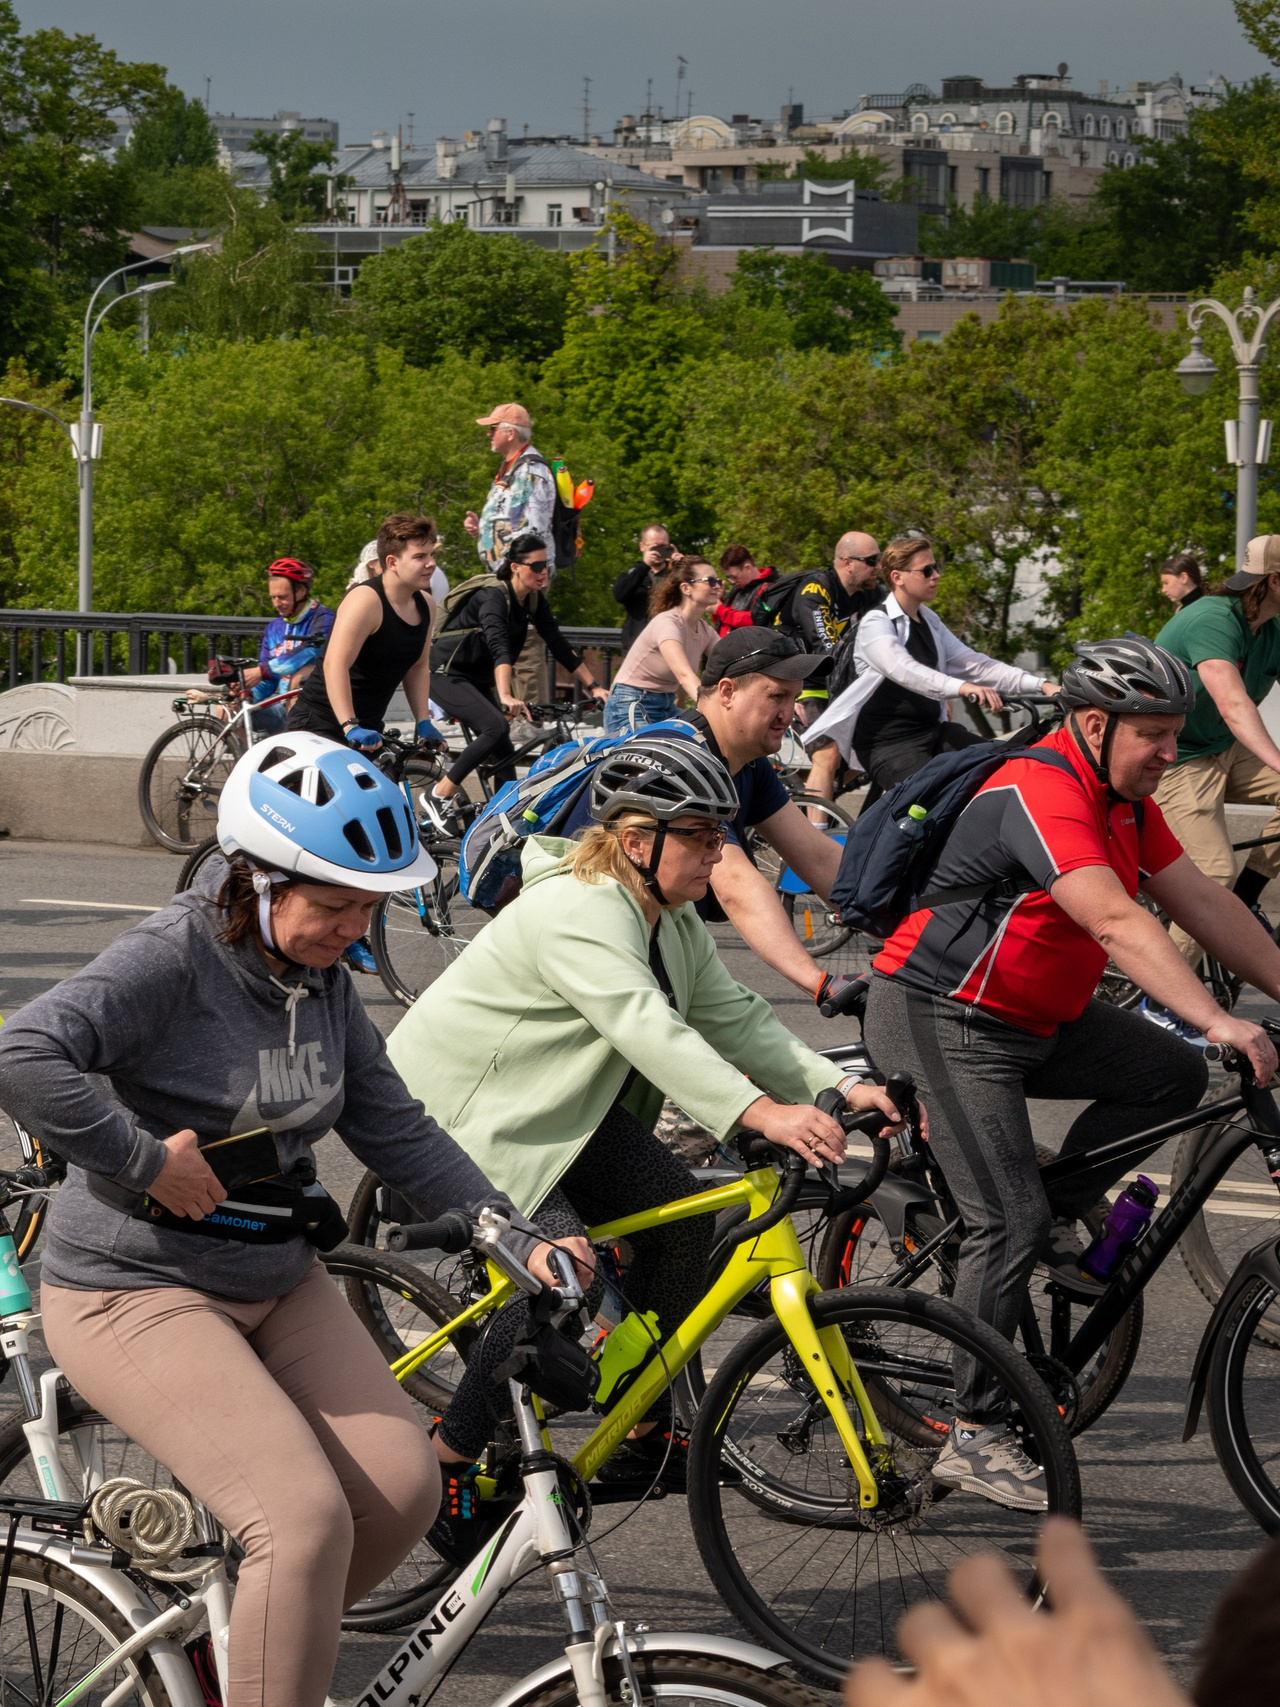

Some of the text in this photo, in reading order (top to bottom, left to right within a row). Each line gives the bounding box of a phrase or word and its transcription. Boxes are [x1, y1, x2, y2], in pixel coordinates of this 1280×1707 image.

[614, 754, 656, 767] GIRO
[260, 803, 296, 833] STERN
[258, 1041, 332, 1104] NIKE
[203, 1213, 267, 1232] самолет
[584, 1396, 642, 1469] MERIDA
[722, 1434, 766, 1478] SOURCE
